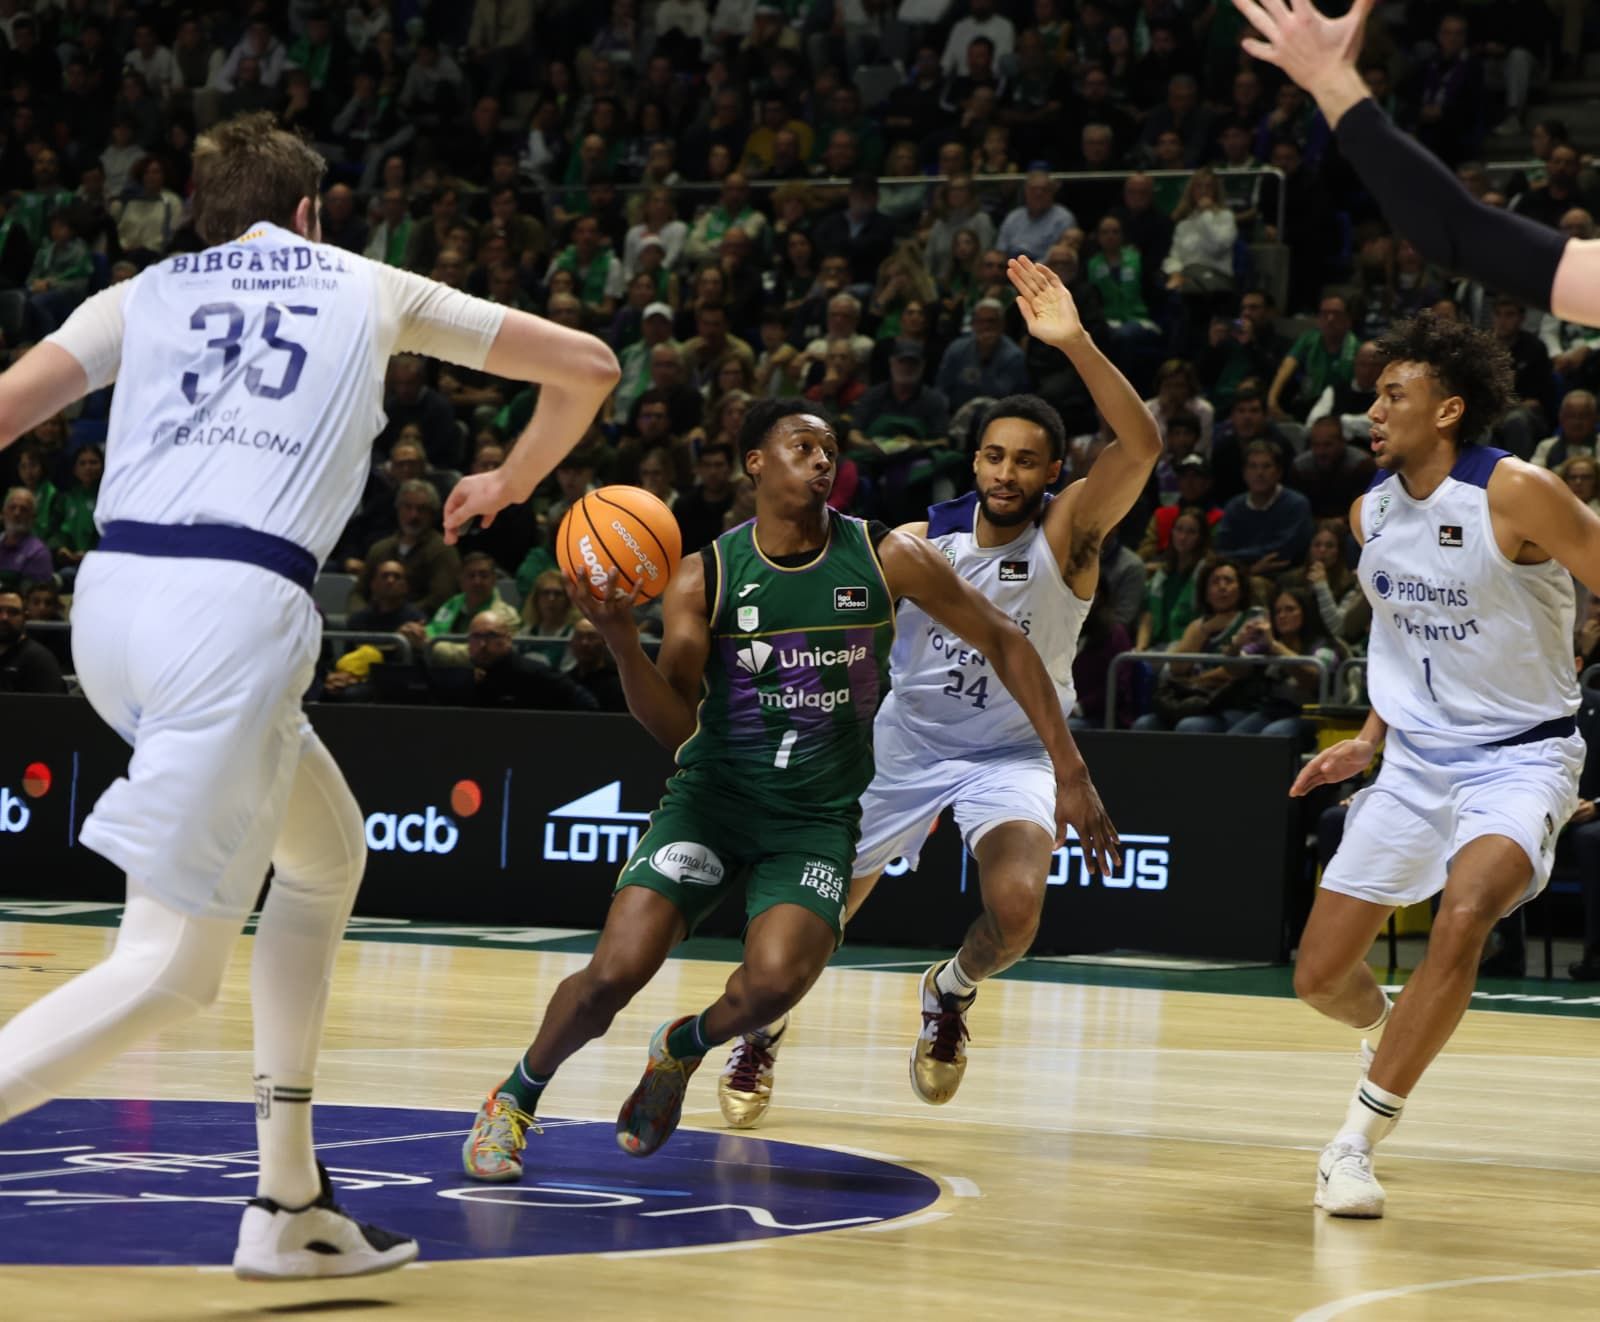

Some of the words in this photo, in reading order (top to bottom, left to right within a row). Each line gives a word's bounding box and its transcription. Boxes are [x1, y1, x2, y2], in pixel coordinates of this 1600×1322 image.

[181, 301, 318, 405] 35
[779, 644, 868, 669] Unicaja
[943, 669, 989, 709] 24
[1422, 657, 1438, 702] 1
[774, 729, 799, 769] 1
[364, 806, 459, 854] acb
[543, 822, 639, 863] LOT
[1046, 846, 1169, 891] OTUS
